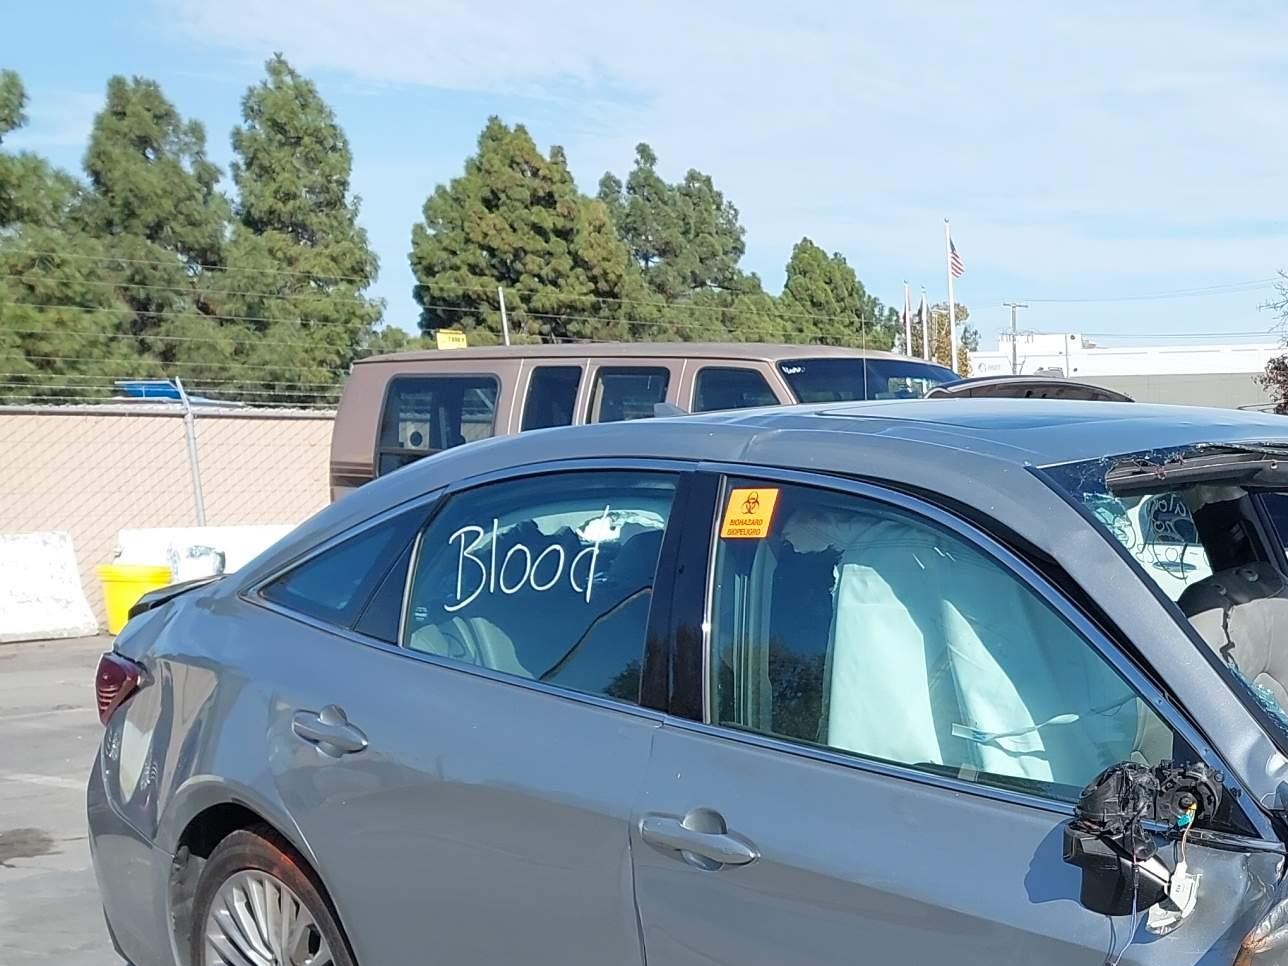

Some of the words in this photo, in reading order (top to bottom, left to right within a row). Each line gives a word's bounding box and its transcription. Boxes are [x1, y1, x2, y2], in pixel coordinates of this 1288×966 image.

[729, 518, 763, 526] BIOHAZARD
[726, 528, 761, 536] BIOPELIGRO
[443, 505, 610, 611] Blood
